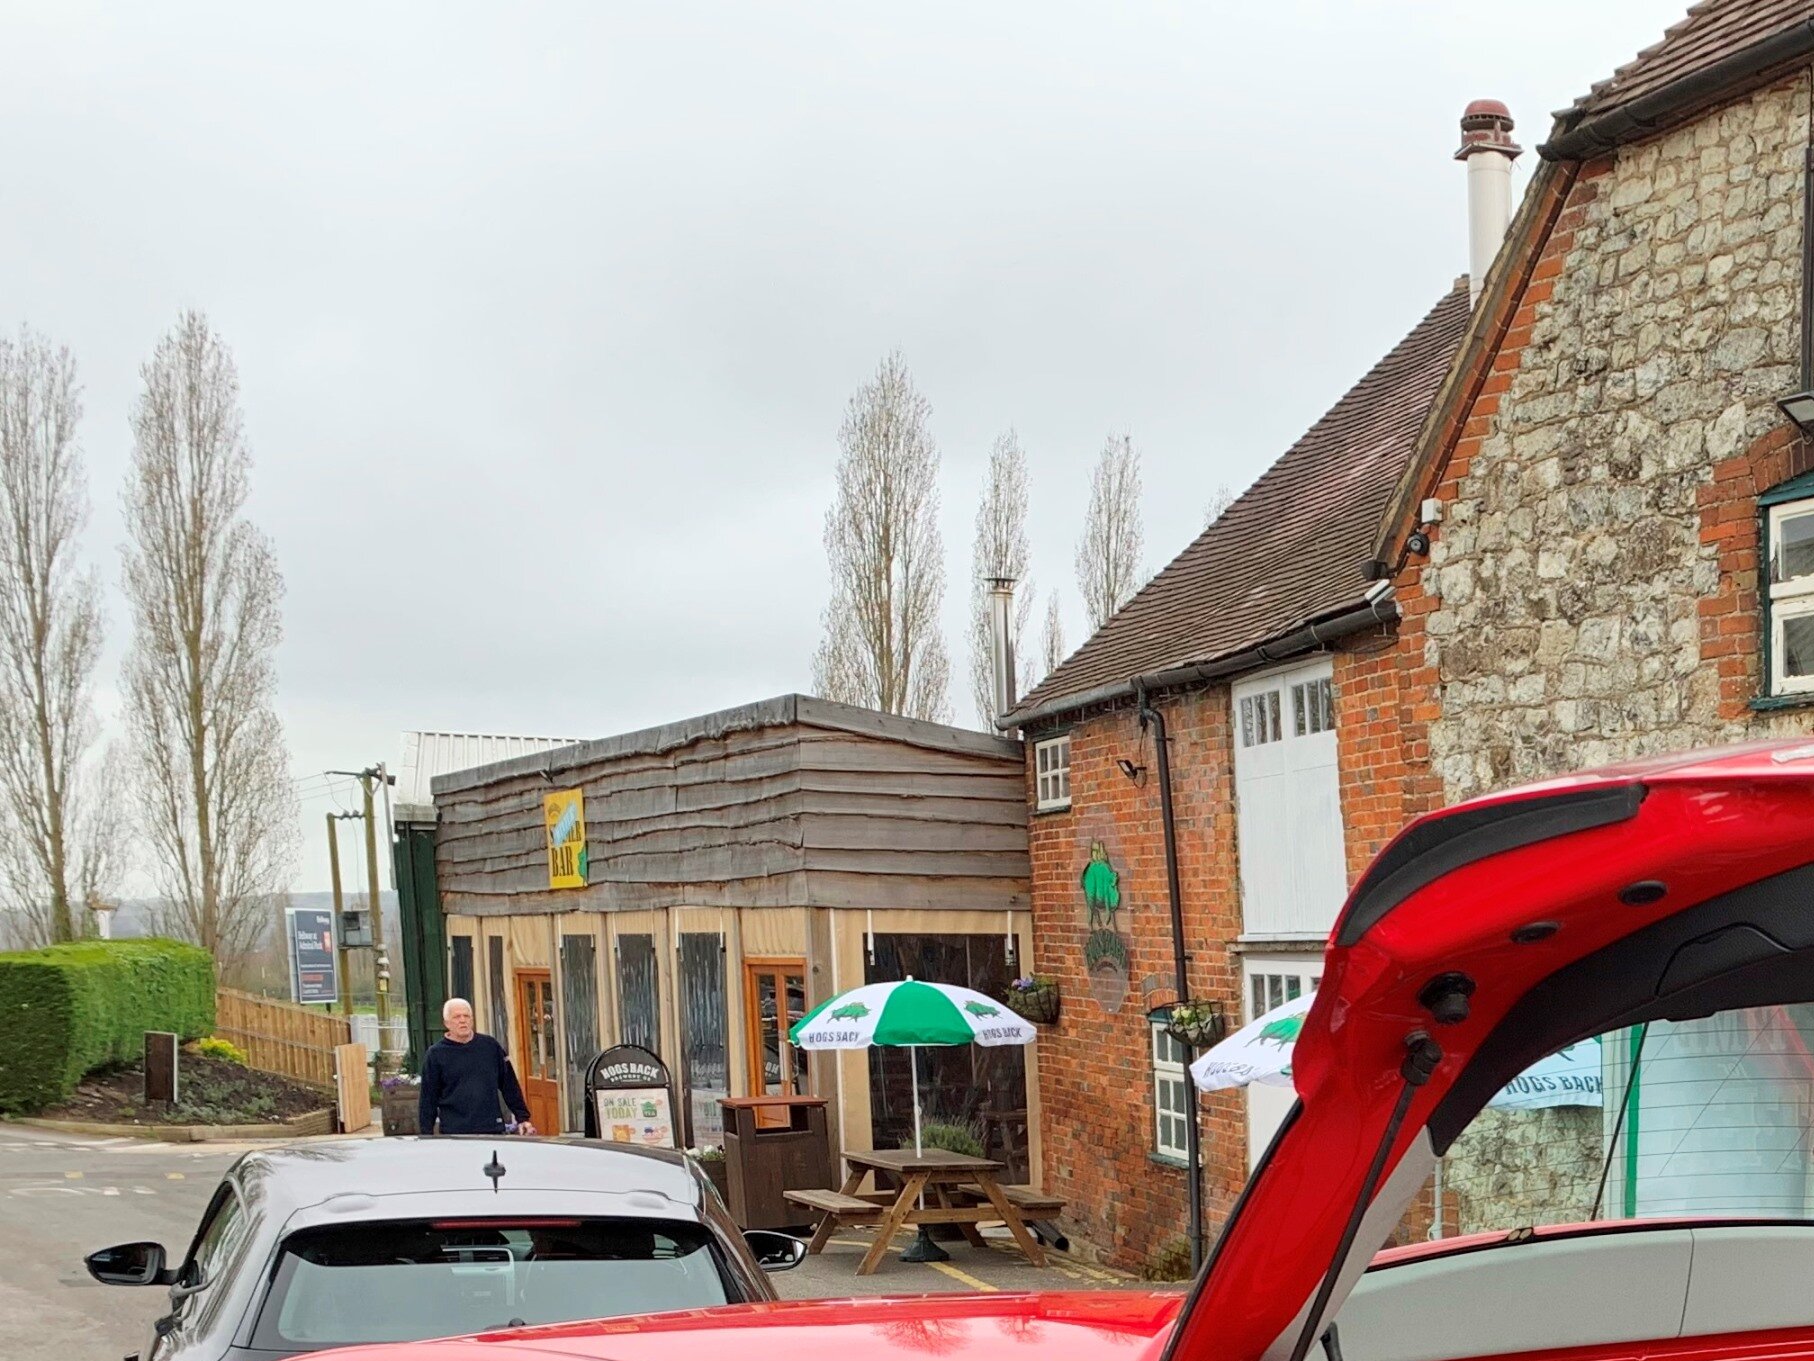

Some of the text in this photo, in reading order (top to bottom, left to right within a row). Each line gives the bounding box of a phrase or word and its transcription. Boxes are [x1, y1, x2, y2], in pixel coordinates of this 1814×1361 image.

[551, 846, 574, 877] BAR
[808, 1031, 835, 1044] HOGS
[600, 1062, 660, 1080] HOGS BACK
[1506, 1076, 1557, 1095] HOGS
[604, 1097, 637, 1107] ON SALE
[606, 1107, 638, 1119] TODAY
